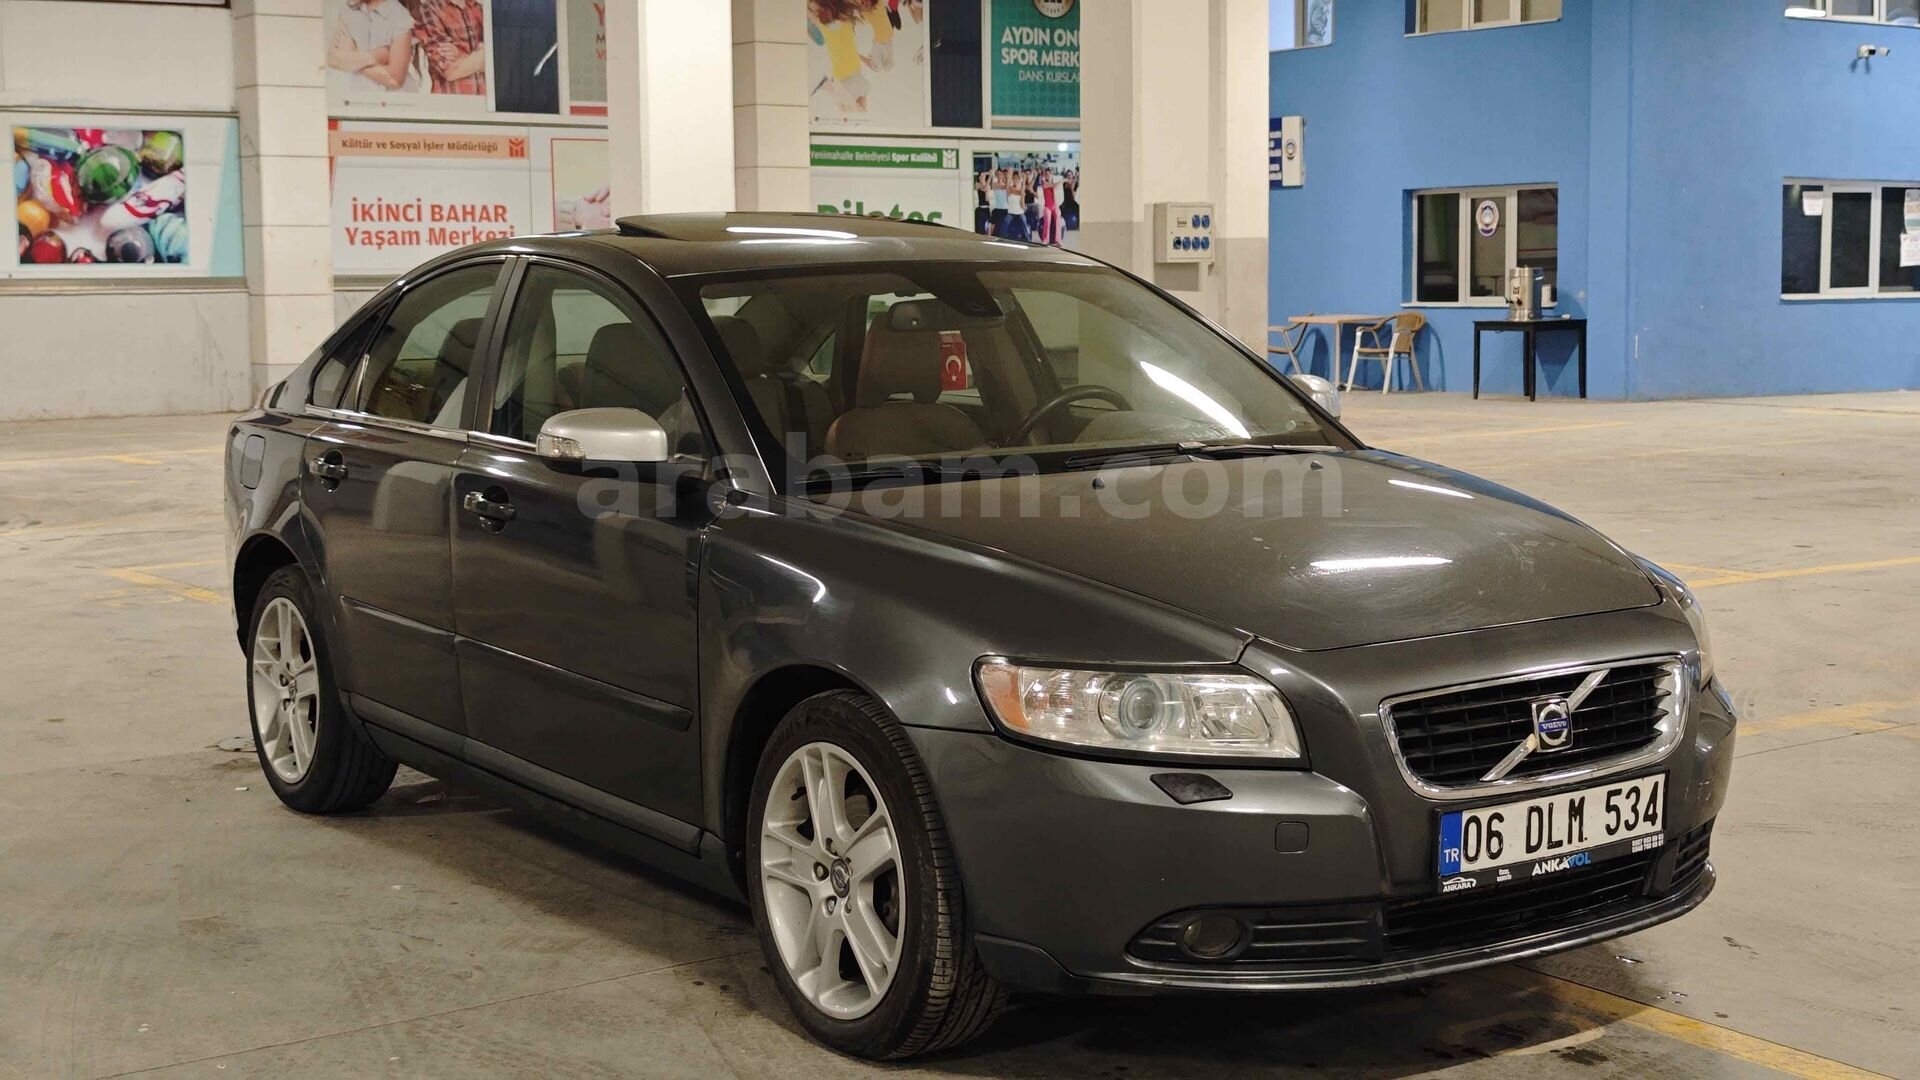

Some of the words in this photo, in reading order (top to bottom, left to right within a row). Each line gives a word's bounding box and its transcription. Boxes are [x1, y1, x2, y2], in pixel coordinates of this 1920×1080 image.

[1001, 26, 1051, 46] AYDIN
[1054, 28, 1080, 48] ON
[1001, 47, 1039, 66] SPOR
[1019, 69, 1045, 82] DANS
[341, 138, 373, 149] Kültür
[376, 141, 388, 150] ve
[389, 140, 421, 152] Sosyal
[423, 139, 445, 152] İşler
[447, 140, 499, 153] Müdürlüğü
[352, 197, 423, 223] İKİNCİ
[430, 203, 508, 223] BAHAR
[345, 226, 421, 250] Yaşam
[1542, 720, 1567, 730] VOLVO
[1462, 811, 1505, 864] 06
[1525, 795, 1587, 854] DLM
[1604, 781, 1660, 836] 534
[1444, 847, 1460, 864] TR
[1442, 881, 1472, 893] ANKARA
